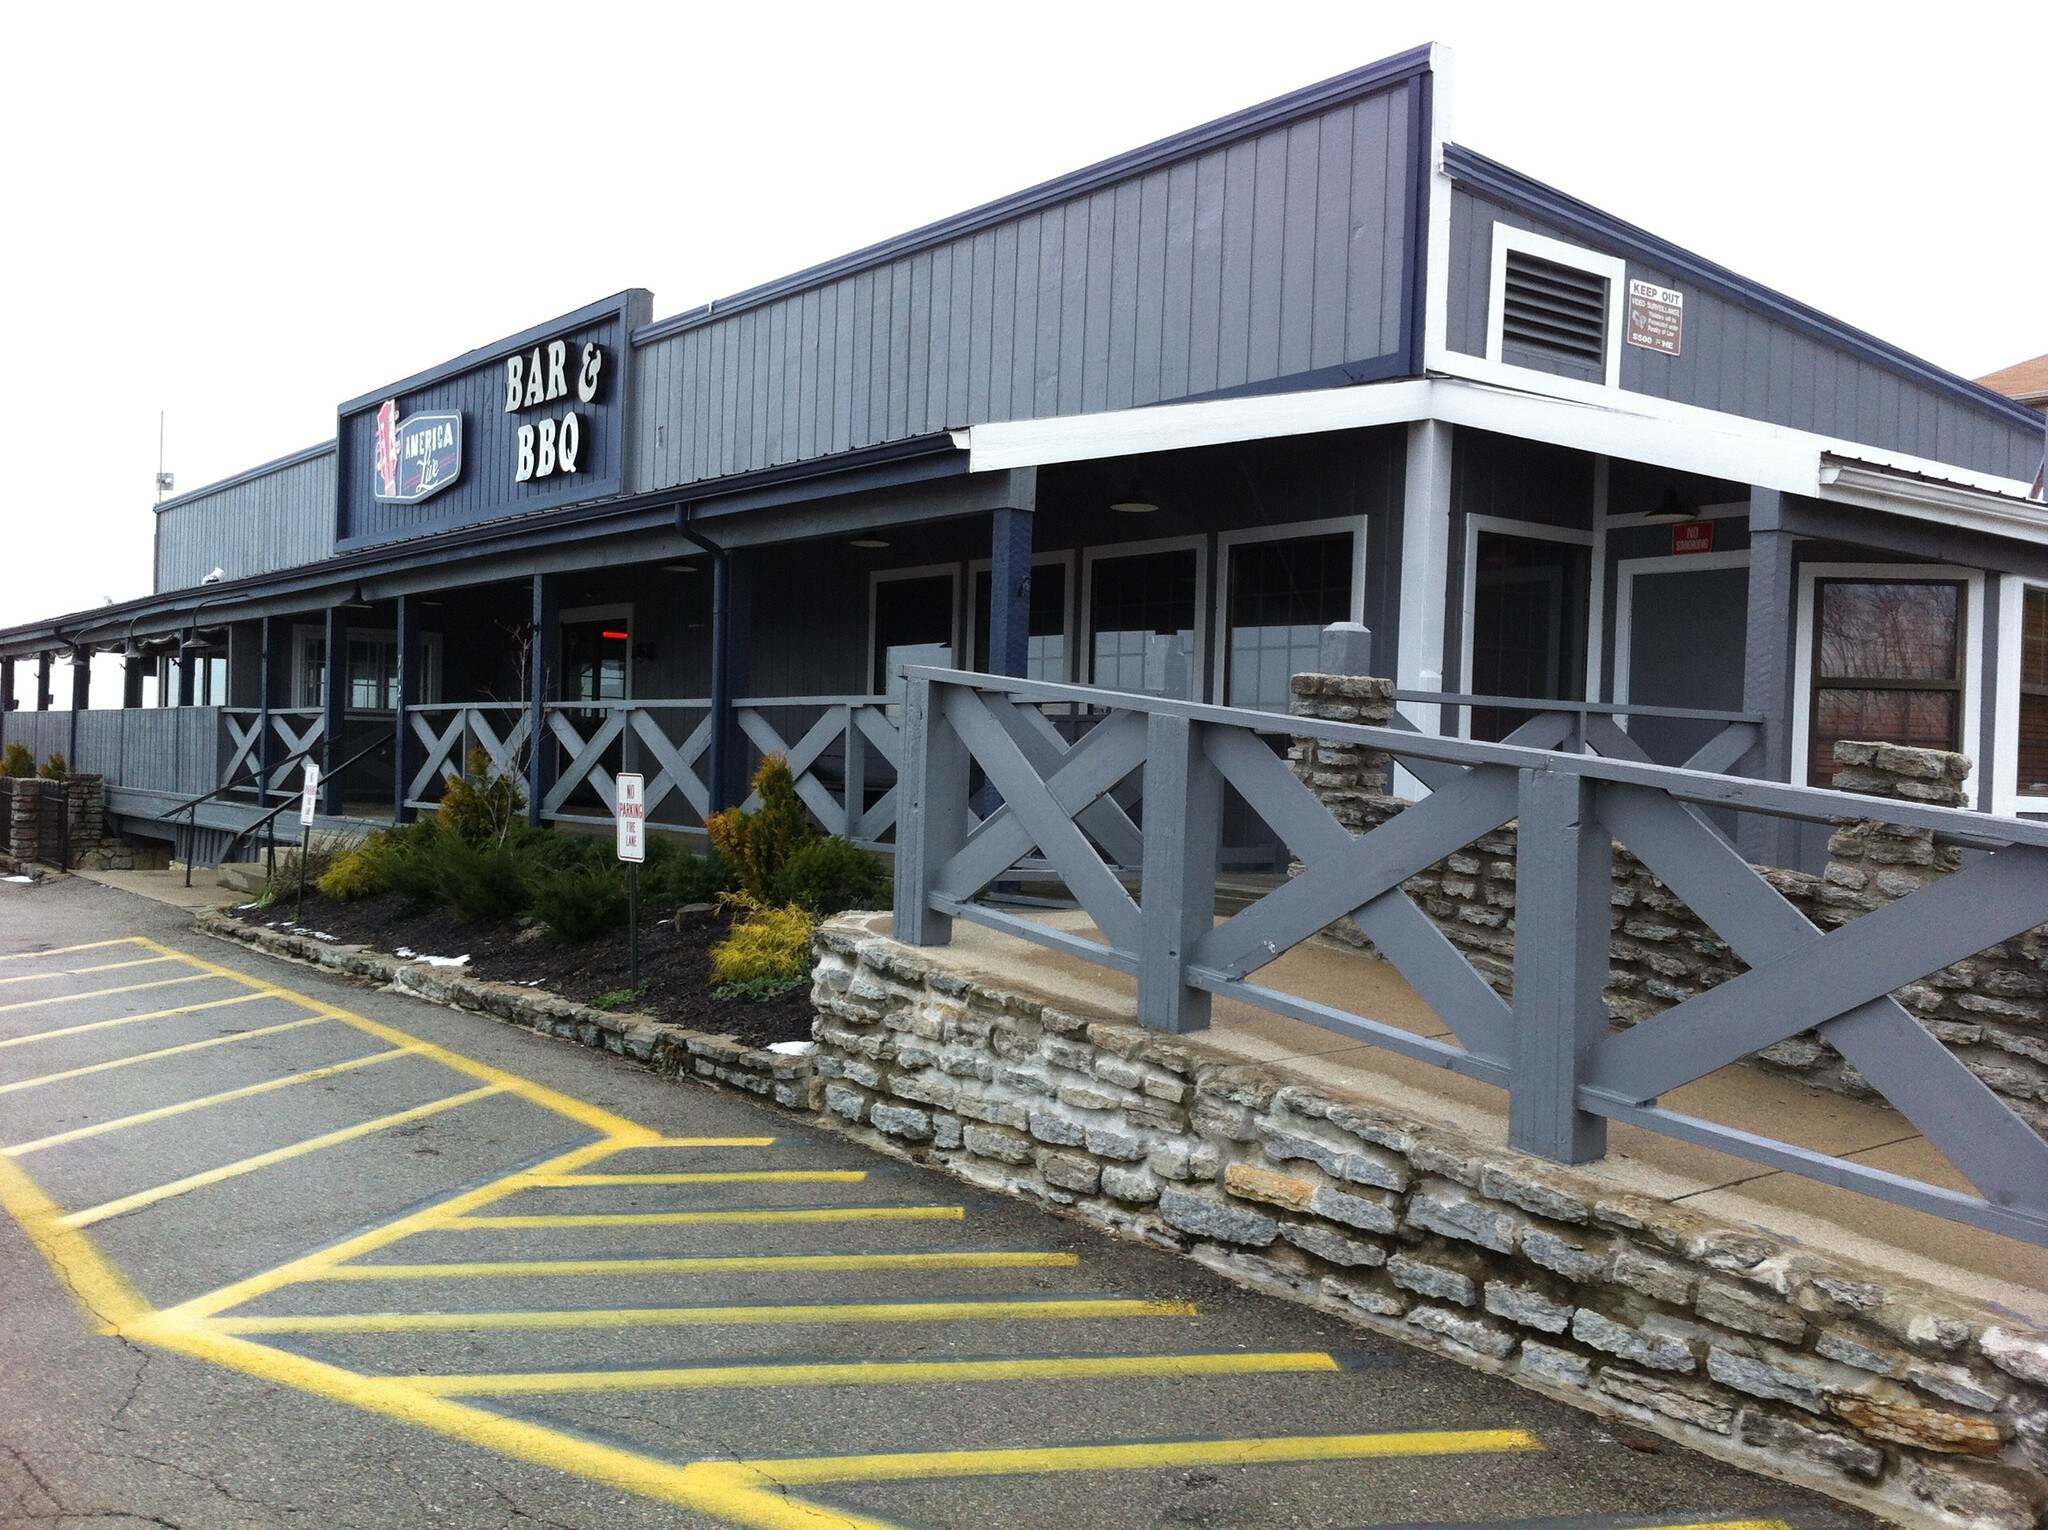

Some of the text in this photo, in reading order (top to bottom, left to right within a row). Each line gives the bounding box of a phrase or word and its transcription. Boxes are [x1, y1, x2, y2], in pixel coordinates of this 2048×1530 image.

[1633, 282, 1680, 305] KEEP OUT
[1632, 297, 1680, 317] VIDEO SURVEILLANCE
[505, 340, 602, 413] BAR &
[405, 422, 453, 460] AMERICA
[515, 411, 579, 482] BBQ
[416, 445, 439, 493] Live
[1687, 526, 1698, 539] NO
[626, 784, 635, 799] NO
[619, 802, 643, 819] PARKING
[626, 821, 636, 833] FIRE
[626, 835, 637, 847] LANE
